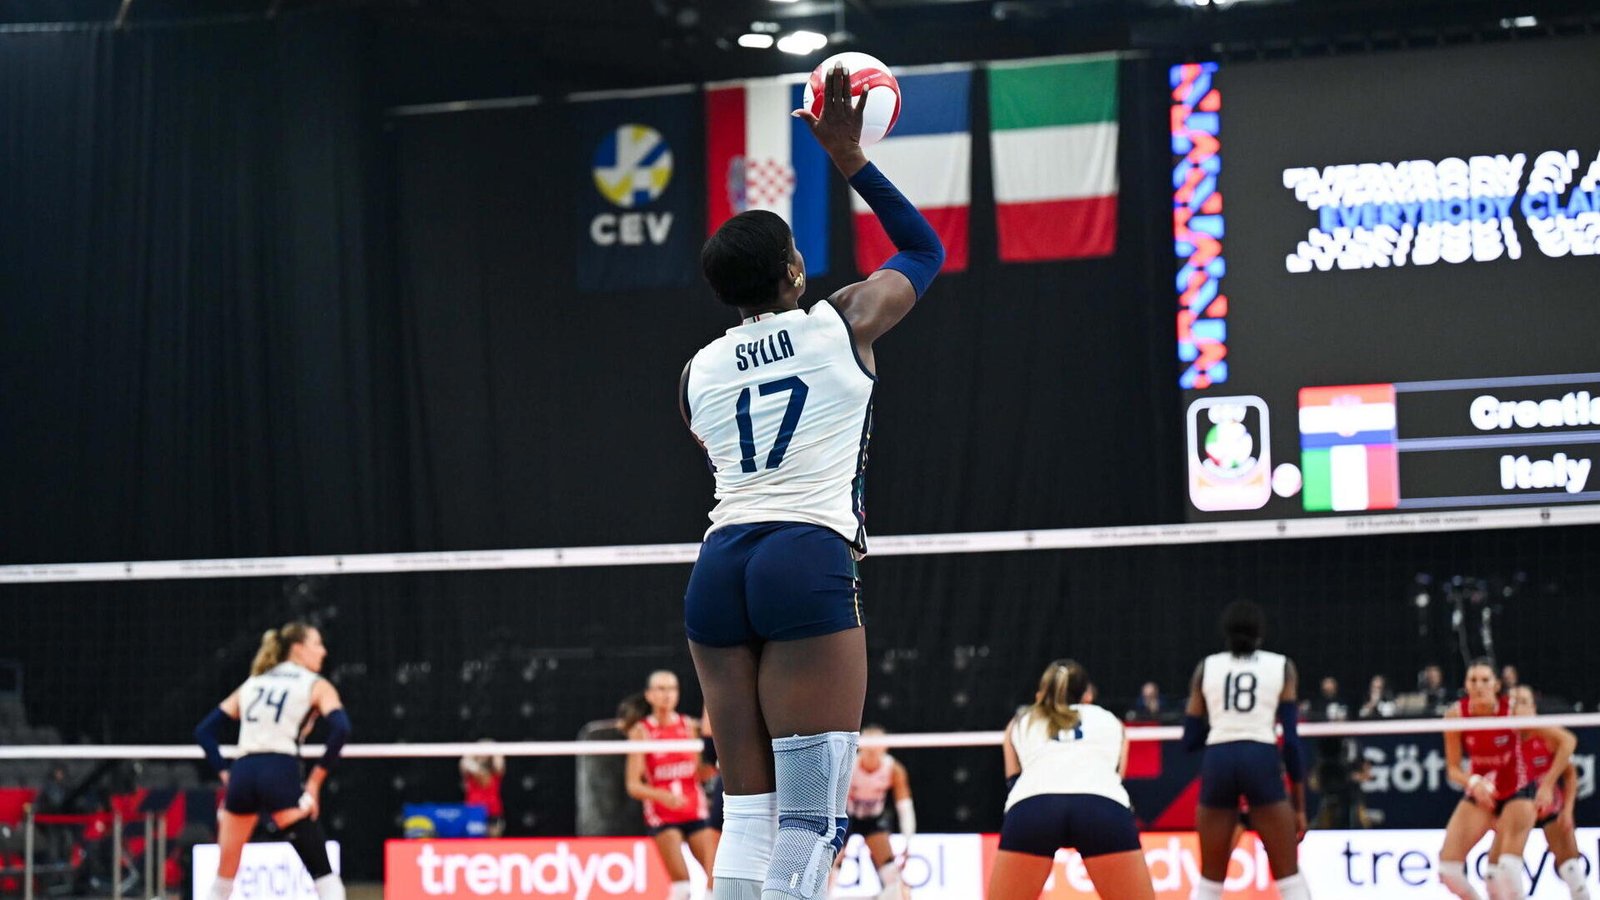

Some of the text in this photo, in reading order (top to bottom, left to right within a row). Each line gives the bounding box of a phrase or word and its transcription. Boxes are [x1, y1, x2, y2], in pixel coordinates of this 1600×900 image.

[590, 211, 673, 247] CEV
[735, 329, 795, 371] SYLLA
[735, 375, 810, 473] 17
[1500, 453, 1592, 494] Italy
[246, 687, 288, 723] 24
[1223, 672, 1257, 712] 18
[417, 842, 648, 900] trendyol
